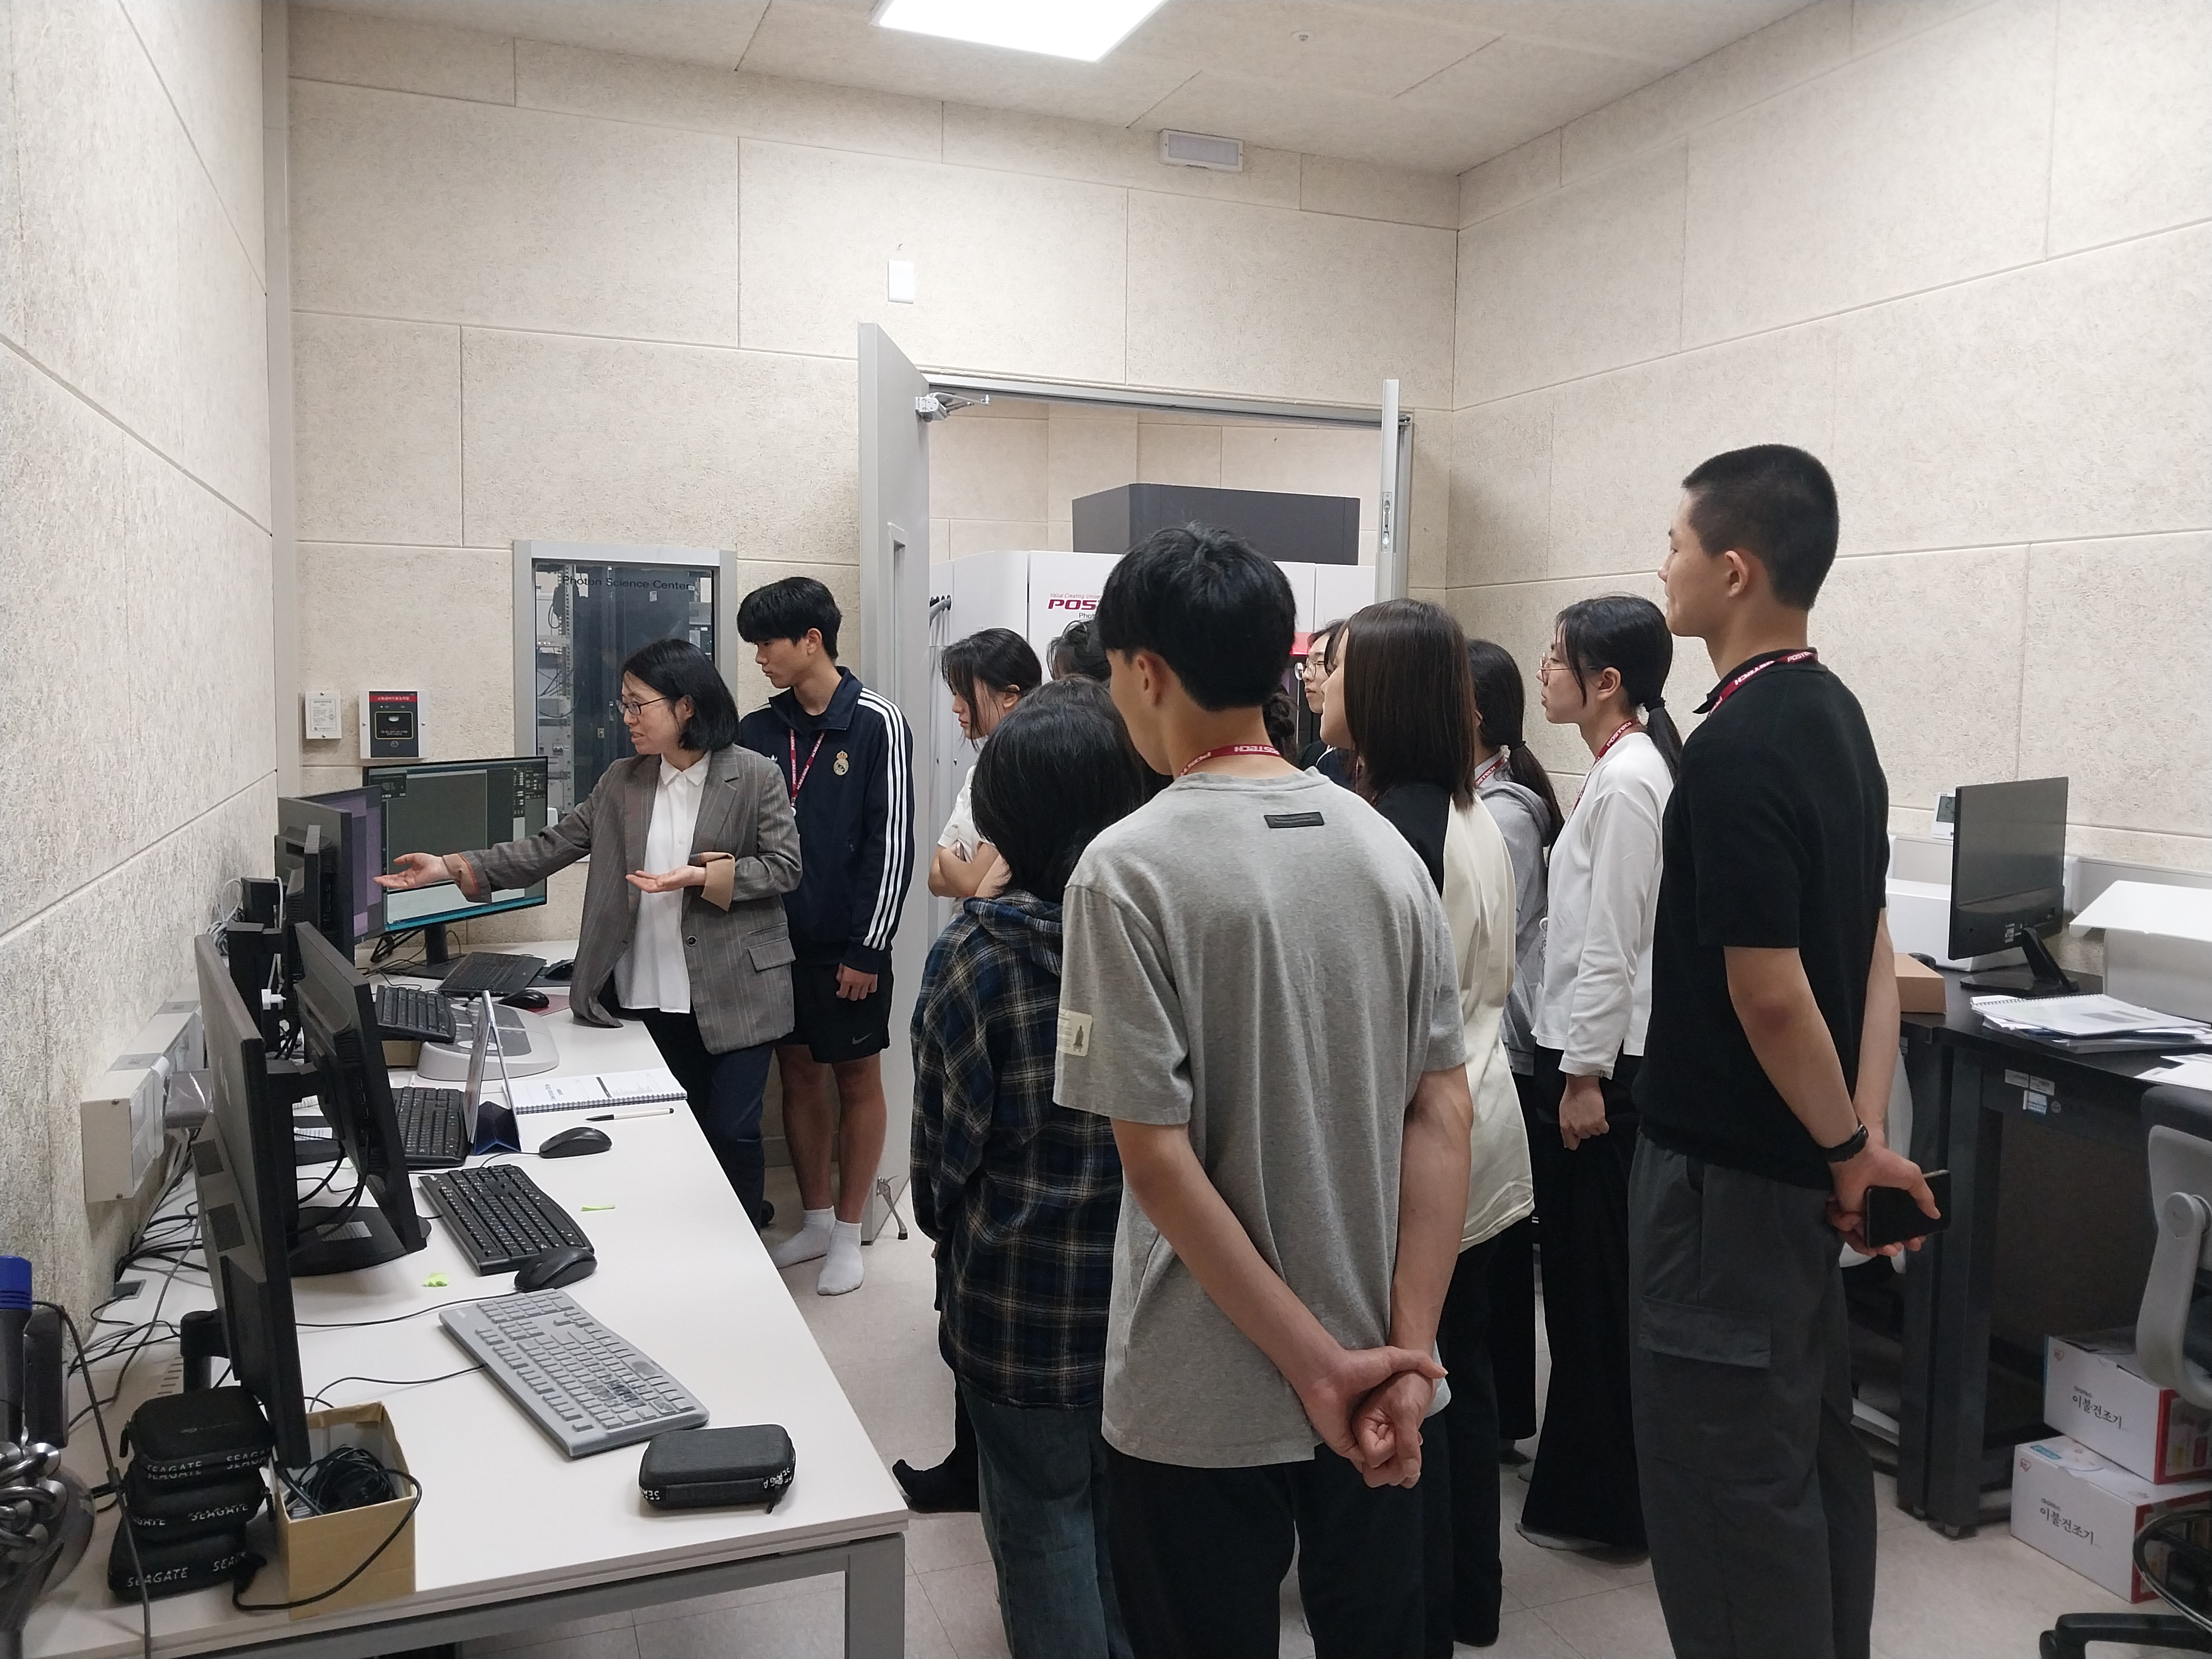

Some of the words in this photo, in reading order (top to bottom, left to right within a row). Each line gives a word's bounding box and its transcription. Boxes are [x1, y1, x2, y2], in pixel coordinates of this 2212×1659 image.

[562, 576, 602, 586] Photon
[606, 578, 650, 588] Science
[653, 580, 690, 590] Center
[1048, 599, 1100, 610] POS
[1606, 721, 1632, 747] POSTECH
[1475, 766, 1496, 786] OSTECH
[2072, 1395, 2122, 1429] 이불건조기
[2040, 1507, 2094, 1545] 이불건조기
